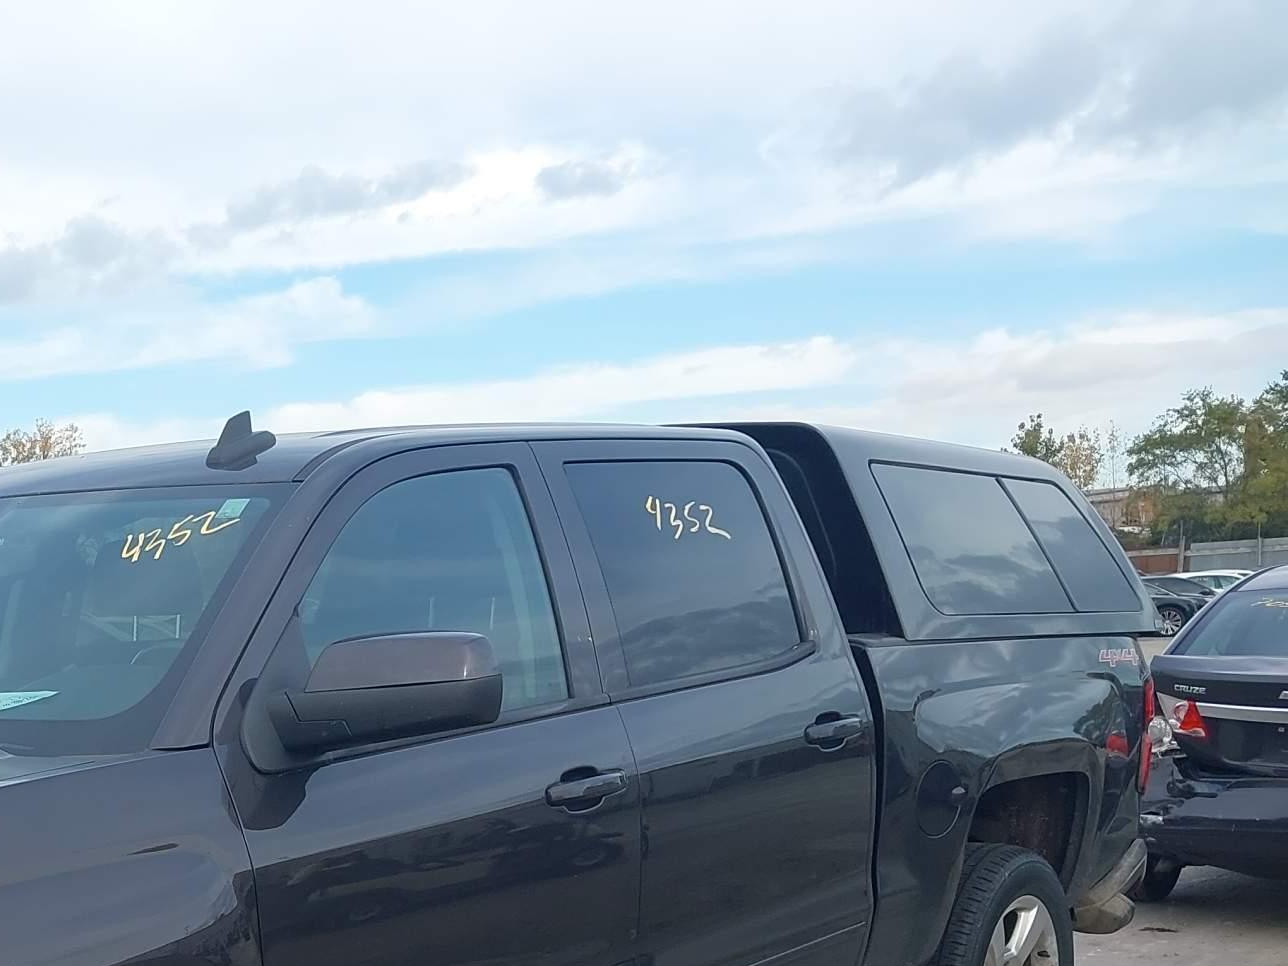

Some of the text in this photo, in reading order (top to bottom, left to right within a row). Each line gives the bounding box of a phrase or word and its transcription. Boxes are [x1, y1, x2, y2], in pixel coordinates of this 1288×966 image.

[121, 511, 240, 563] 4352
[646, 496, 731, 539] 4352
[1174, 684, 1207, 694] CRUZE
